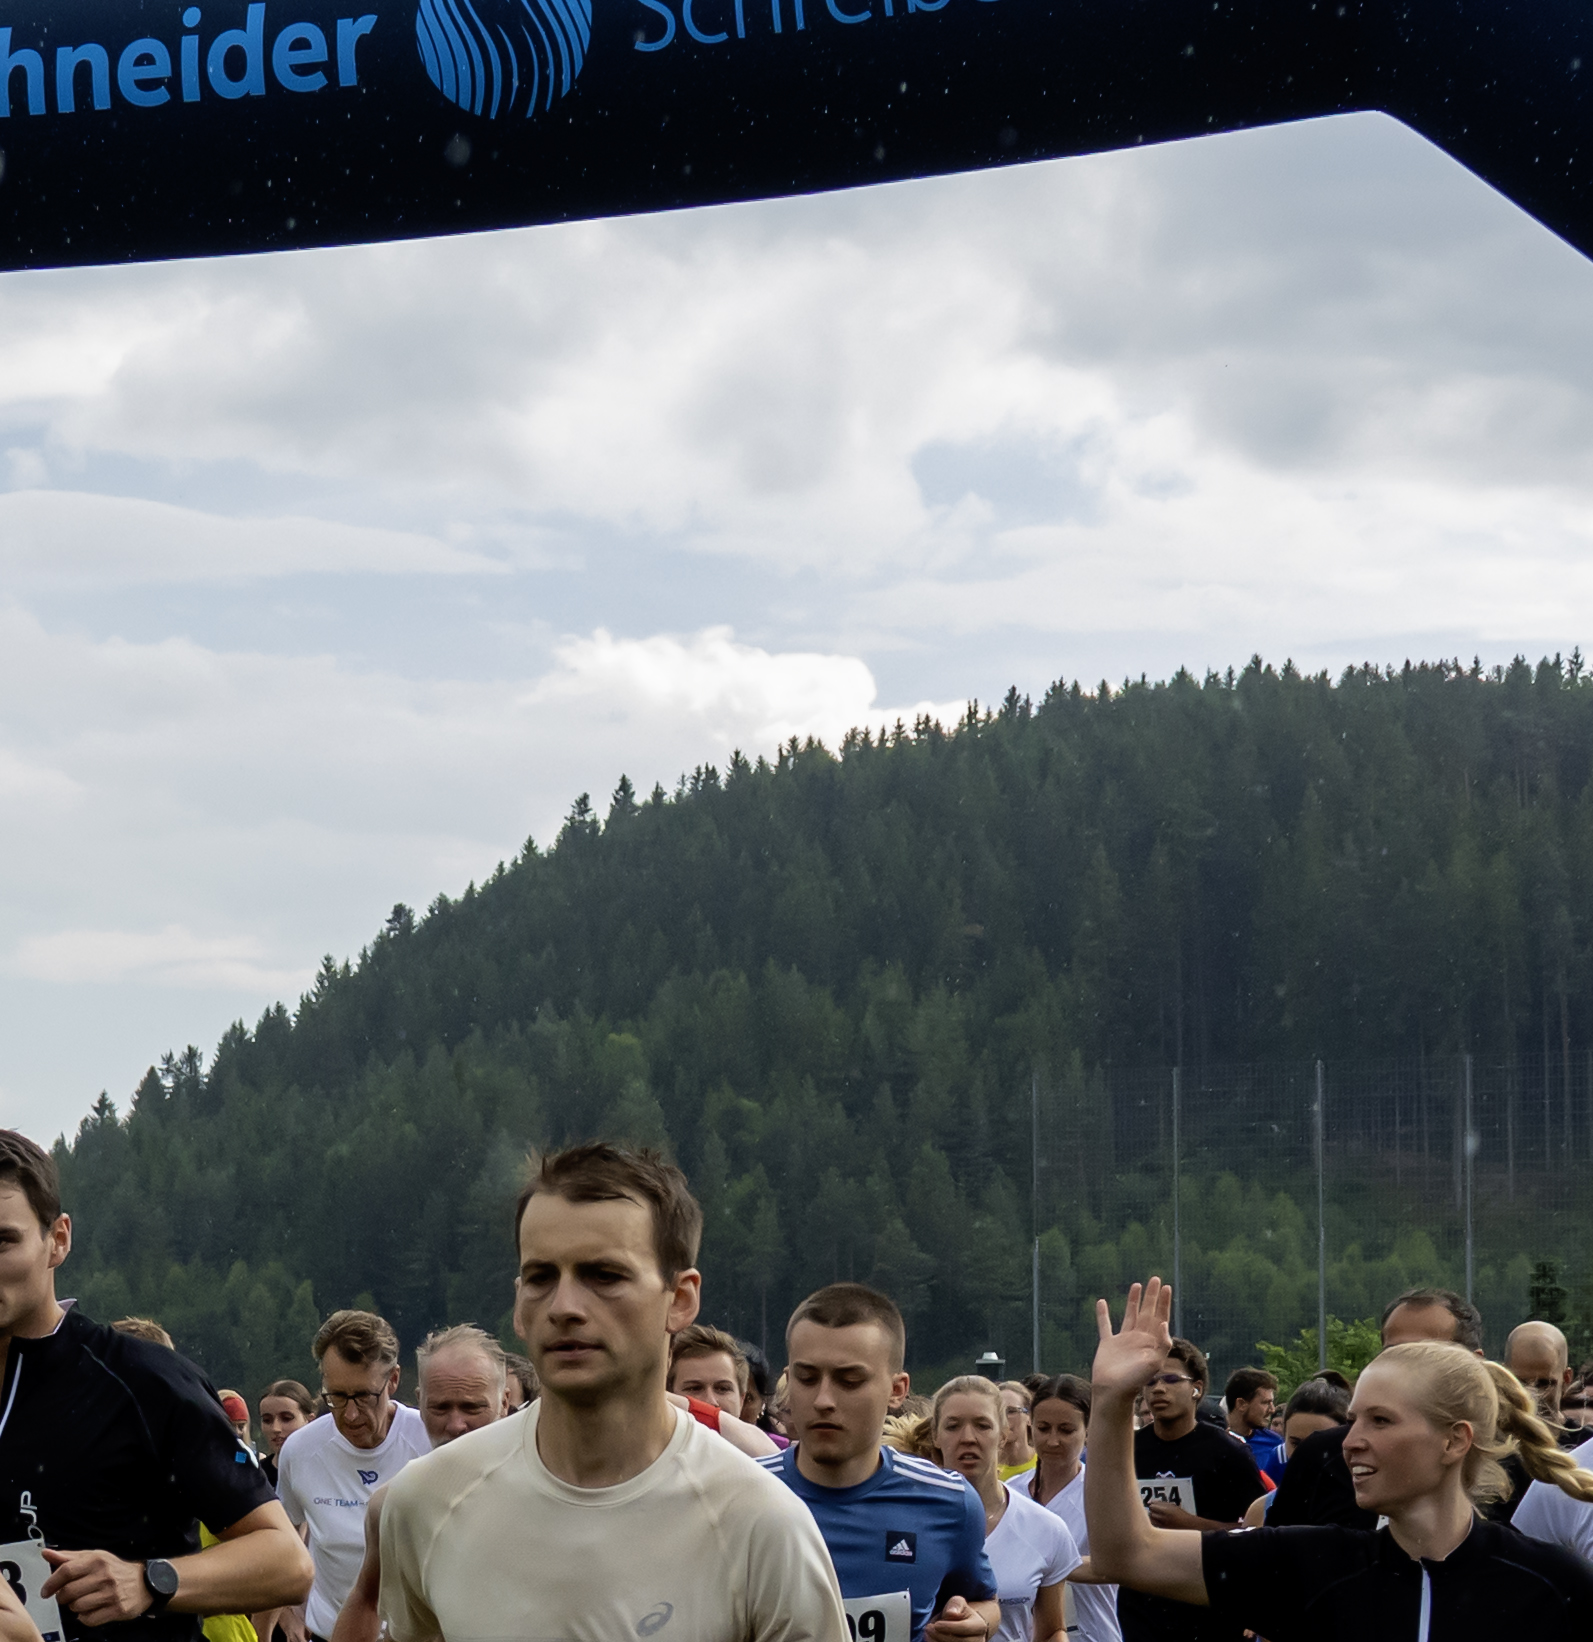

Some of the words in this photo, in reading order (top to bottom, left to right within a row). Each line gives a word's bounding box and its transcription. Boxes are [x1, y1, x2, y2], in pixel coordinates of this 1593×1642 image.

[313, 1497, 332, 1505] ONE
[334, 1498, 358, 1507] TEAM
[1141, 1486, 1182, 1508] 254
